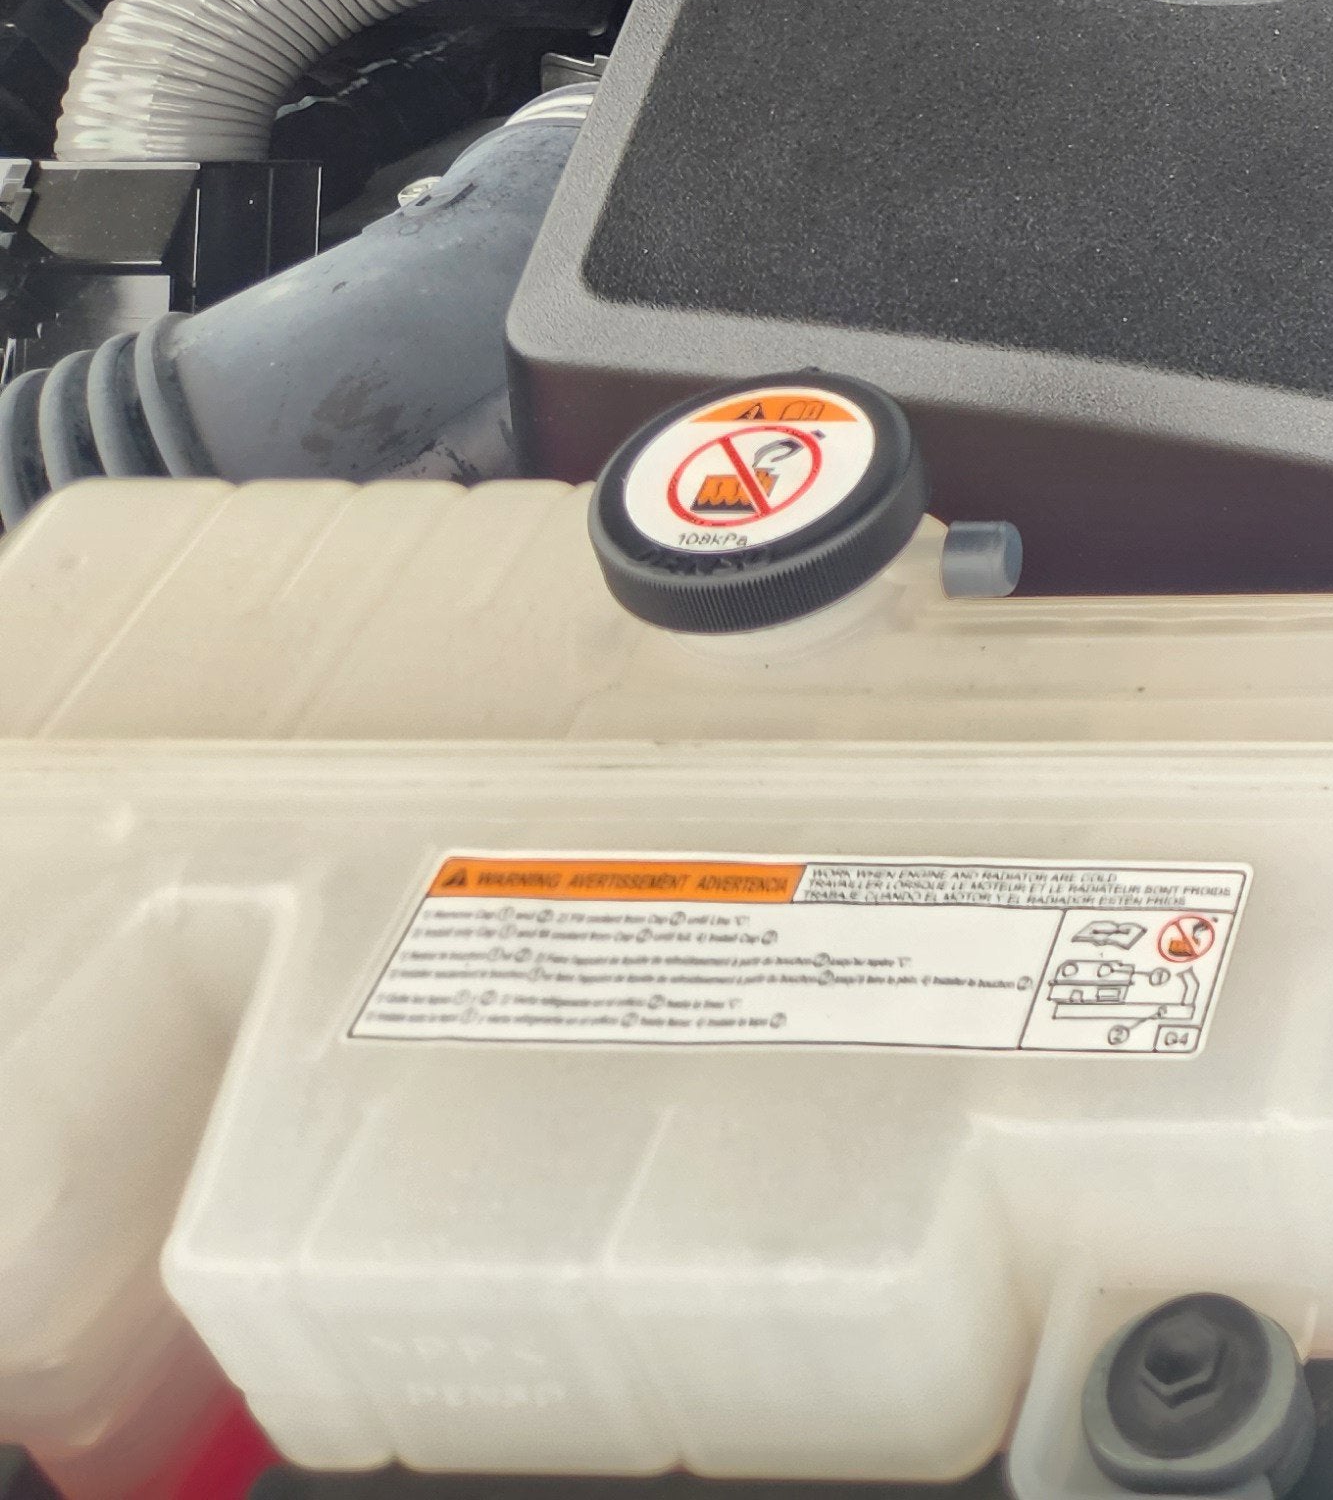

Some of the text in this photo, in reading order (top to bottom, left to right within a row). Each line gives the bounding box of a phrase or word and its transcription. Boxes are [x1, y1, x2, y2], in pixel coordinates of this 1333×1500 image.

[677, 532, 748, 546] 108kPa
[476, 871, 789, 894] WARNING AVERTISSEMENT ADVERTENCIA
